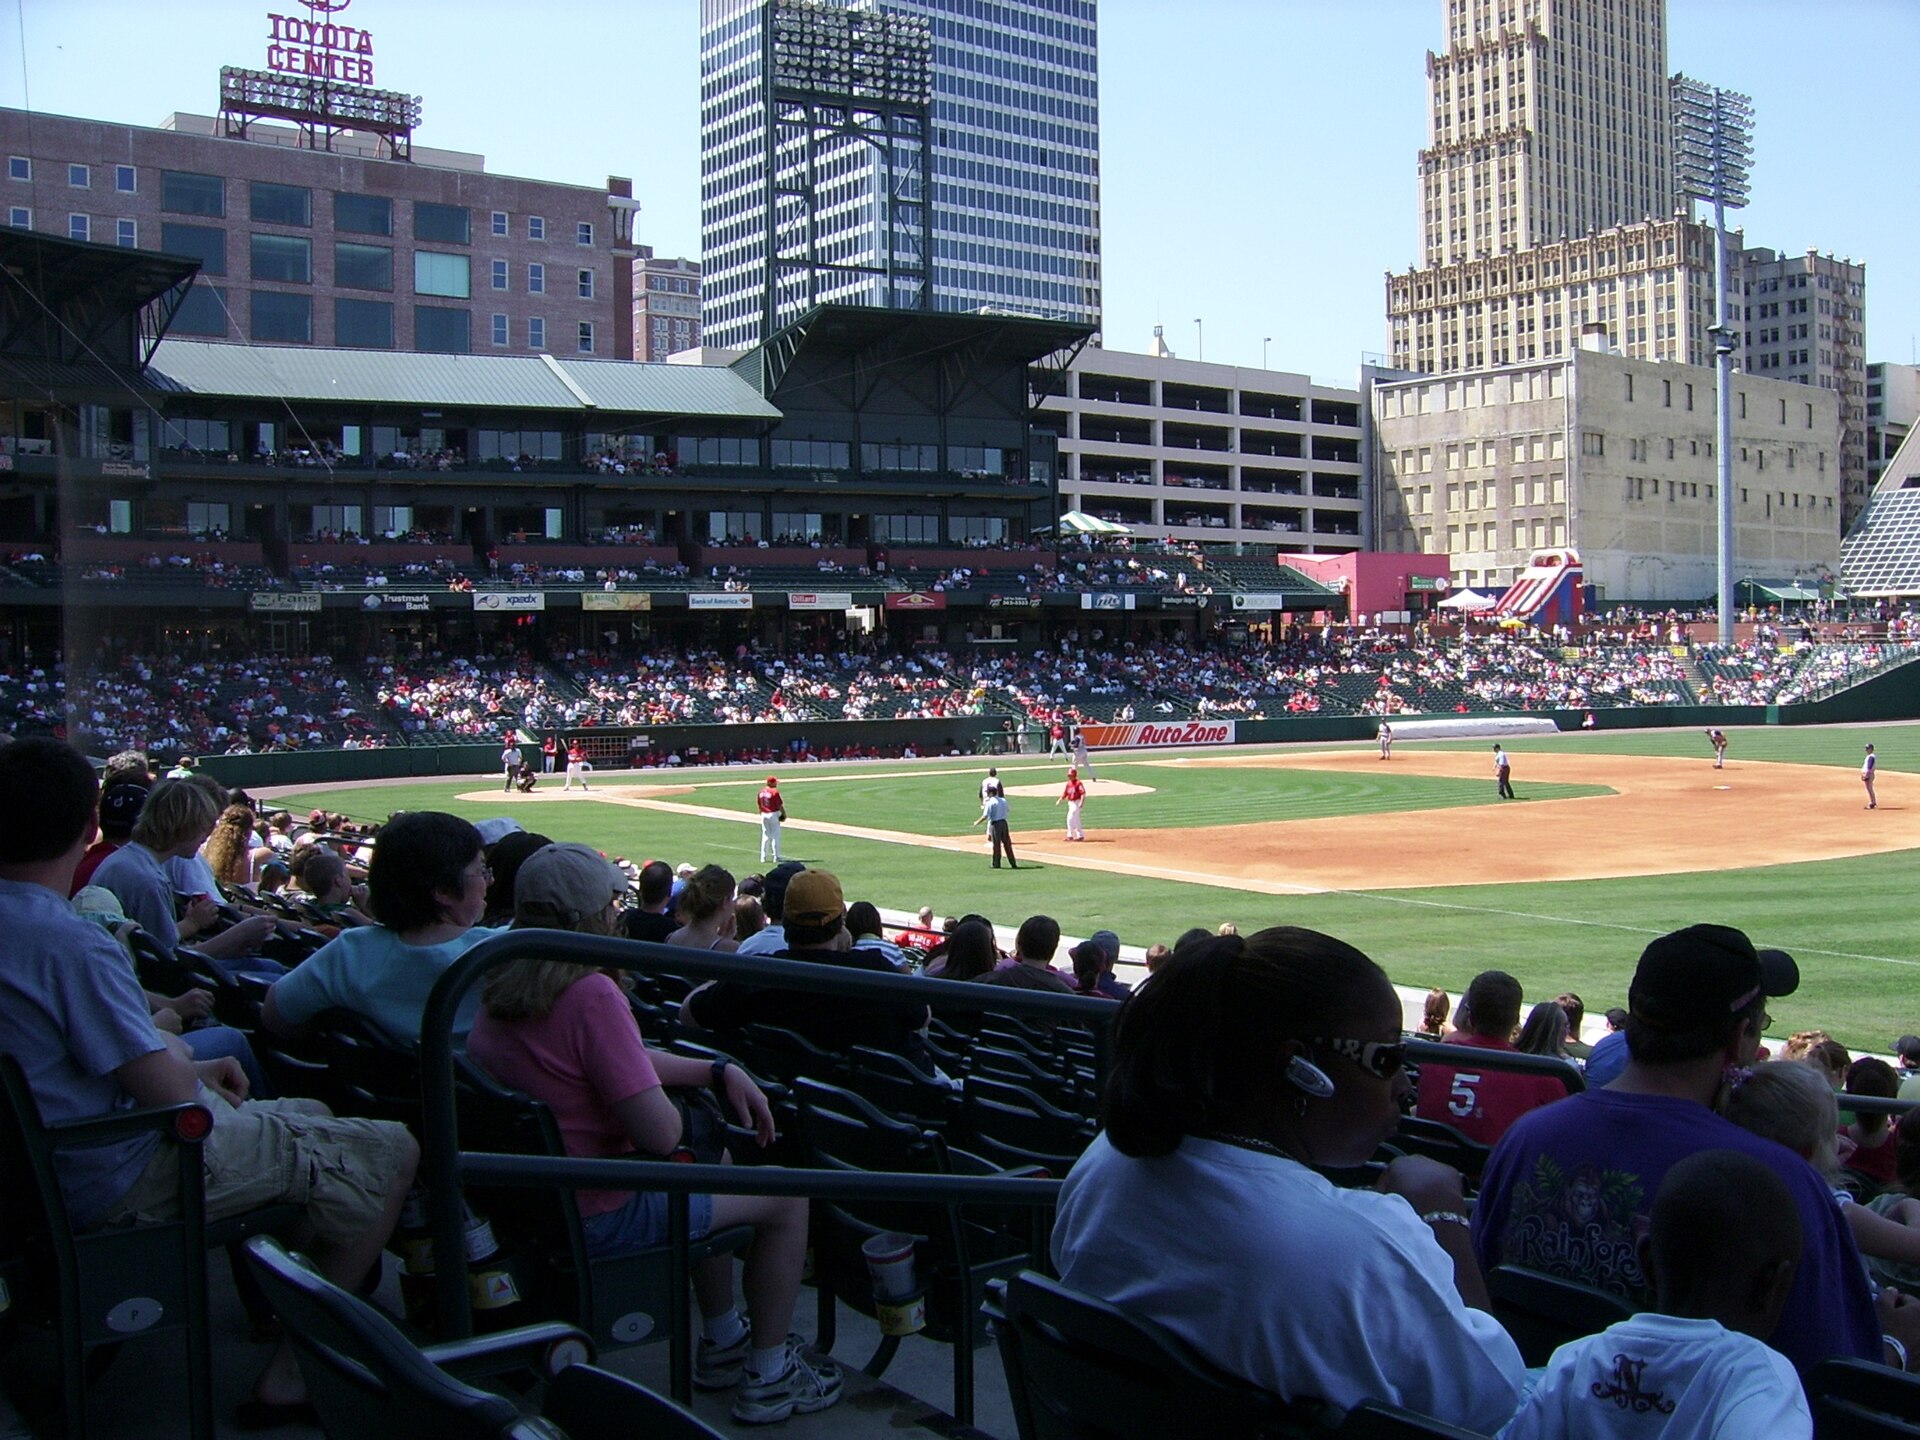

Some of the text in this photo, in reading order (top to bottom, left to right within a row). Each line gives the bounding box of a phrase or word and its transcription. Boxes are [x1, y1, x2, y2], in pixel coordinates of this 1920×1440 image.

[266, 12, 374, 56] TOYOTA
[266, 43, 374, 85] CENTER
[382, 594, 430, 602] Trustmark
[405, 602, 430, 610] Bank
[1136, 723, 1228, 744] AutoZone
[1448, 1073, 1481, 1117] 5
[132, 1309, 139, 1321] P
